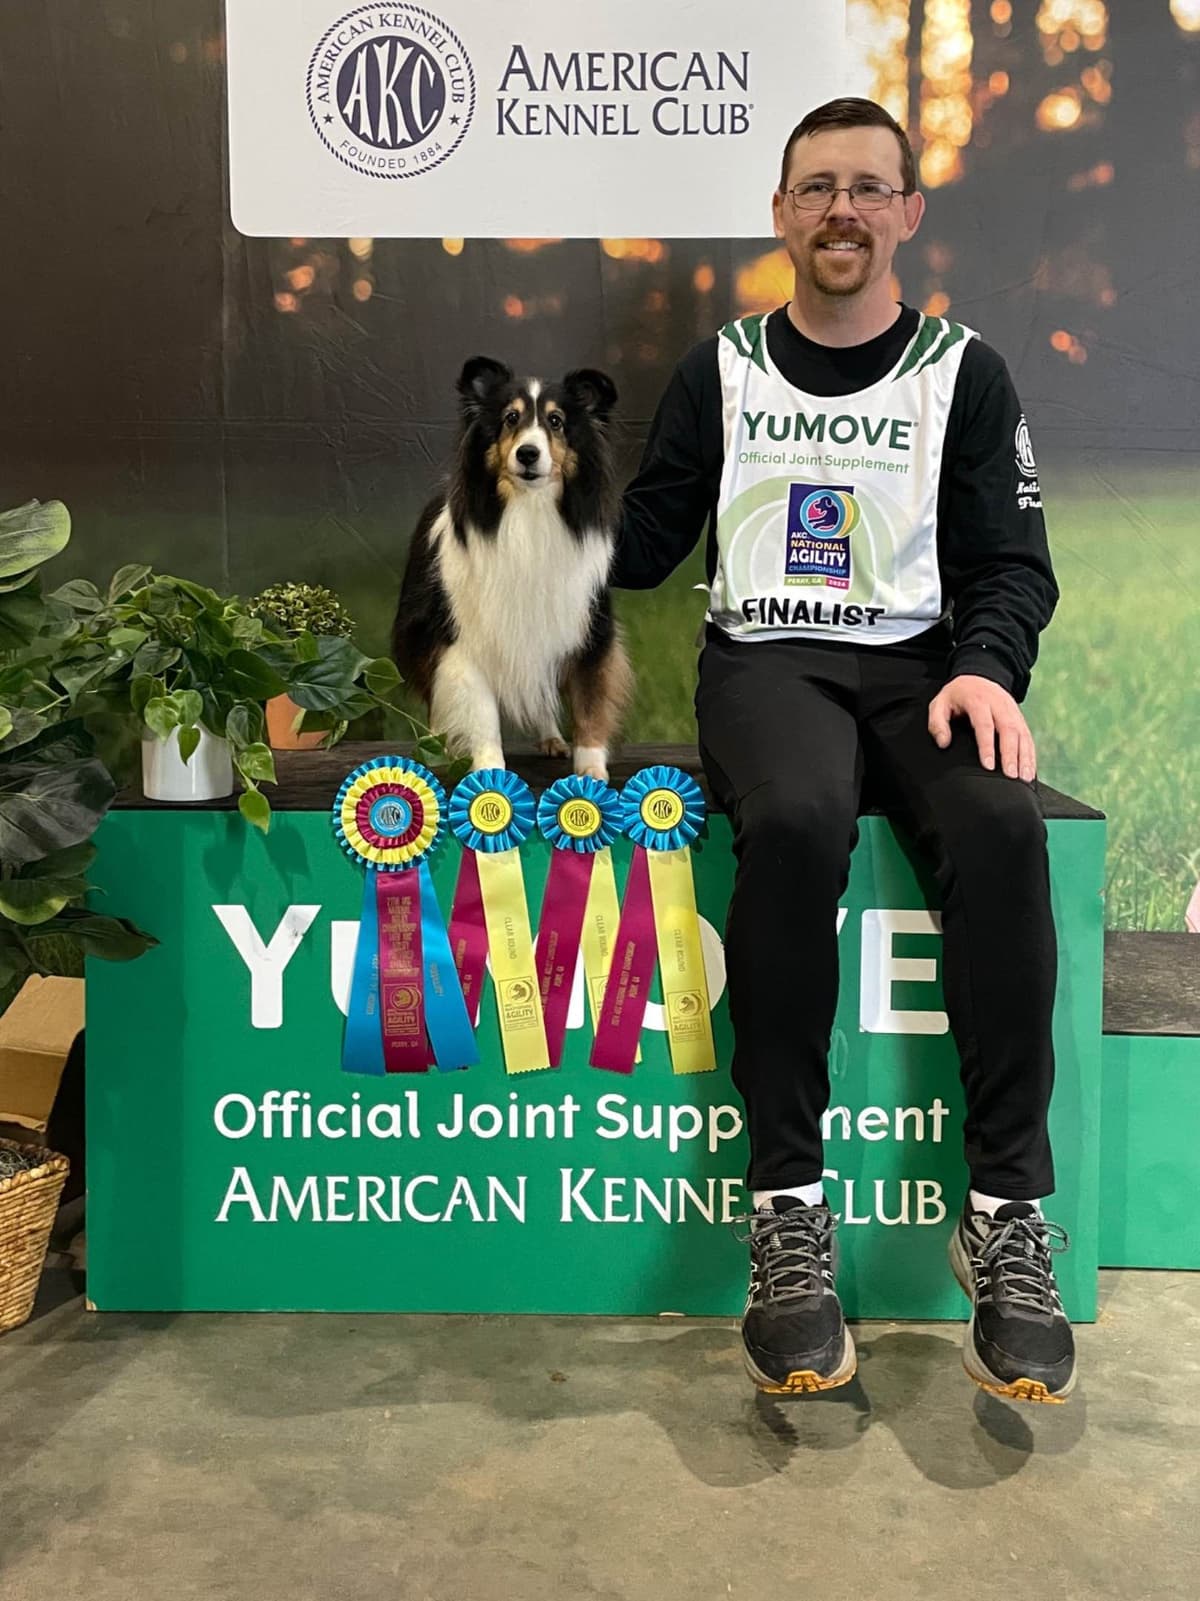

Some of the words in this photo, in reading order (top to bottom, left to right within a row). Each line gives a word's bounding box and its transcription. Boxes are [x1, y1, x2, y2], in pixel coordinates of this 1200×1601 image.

[317, 16, 374, 104] AMERICAN
[379, 13, 448, 53] KENNEL
[445, 53, 465, 104] CLUB
[497, 44, 750, 91] AMERICAN
[342, 39, 440, 147] AKC
[496, 98, 640, 136] KENNEL
[339, 139, 407, 169] FOUNDED
[413, 142, 443, 165] 1884
[738, 452, 786, 465] Official
[789, 454, 822, 466] Joint
[824, 454, 909, 474] Supplement
[791, 531, 808, 539] AKC
[791, 540, 846, 551] NATIONAL
[789, 549, 846, 567] AGILITY
[742, 597, 885, 626] FINALIST
[481, 803, 500, 821] AKC
[570, 808, 589, 827] AKC
[653, 800, 672, 819] AKC
[213, 1090, 421, 1139] Official
[436, 1091, 583, 1139] Joint
[214, 1166, 528, 1224] AMERICAN
[559, 1168, 748, 1224] KENNE
